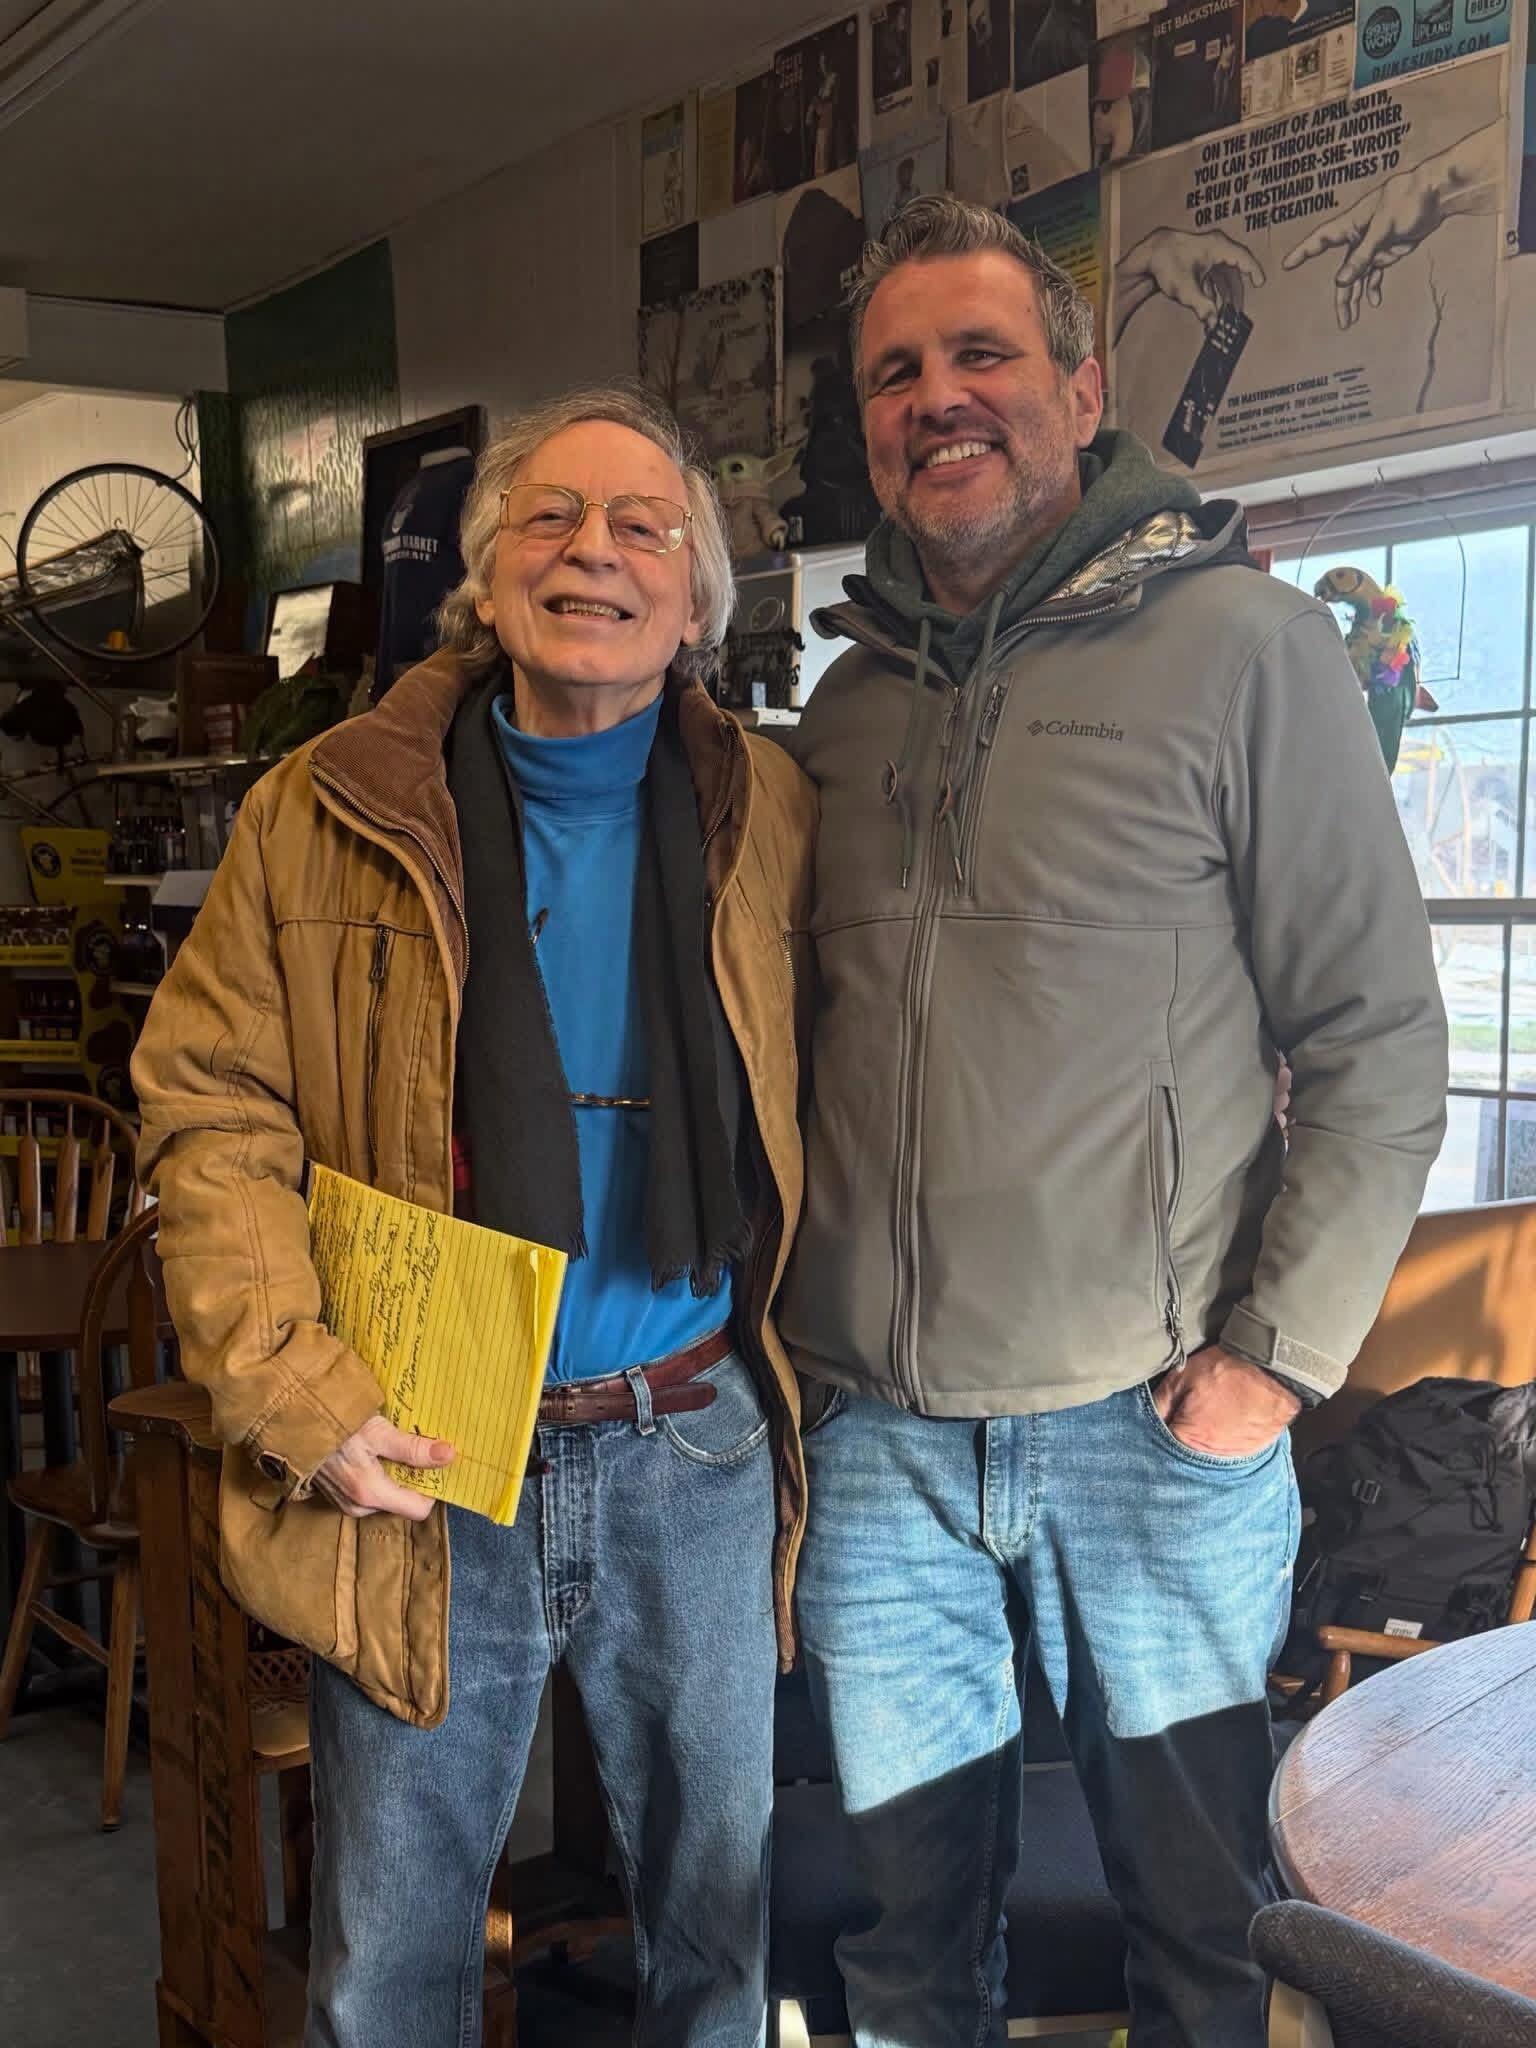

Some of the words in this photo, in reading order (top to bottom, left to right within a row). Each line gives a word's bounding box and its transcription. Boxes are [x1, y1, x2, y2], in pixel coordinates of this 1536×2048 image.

[1153, 19, 1172, 37] GET
[1415, 23, 1450, 41] UPLAND
[1372, 32, 1490, 81] DUKESINDY.COM
[1194, 165, 1217, 186] YOU
[1222, 156, 1245, 176] CAN
[1249, 148, 1269, 168] SIT
[1271, 127, 1335, 162] THROUGH
[1339, 104, 1402, 140] ANOTHER
[1202, 142, 1220, 162] ON
[1223, 134, 1246, 156] THE
[1249, 119, 1289, 147] NIGHT
[1291, 113, 1309, 134] OF
[1311, 98, 1348, 126] APRIL
[1186, 185, 1230, 210] RE-RUN
[1233, 173, 1250, 194] OF
[1195, 207, 1212, 227] OR
[1215, 202, 1229, 221] BE
[1231, 198, 1241, 217] A
[1244, 175, 1314, 212] FIRSTHAND
[1318, 157, 1377, 190] WITNESS
[1381, 150, 1399, 172] TO
[1244, 211, 1268, 233] THE
[1271, 190, 1339, 225] CREATION.
[1046, 720, 1123, 742] Columbia
